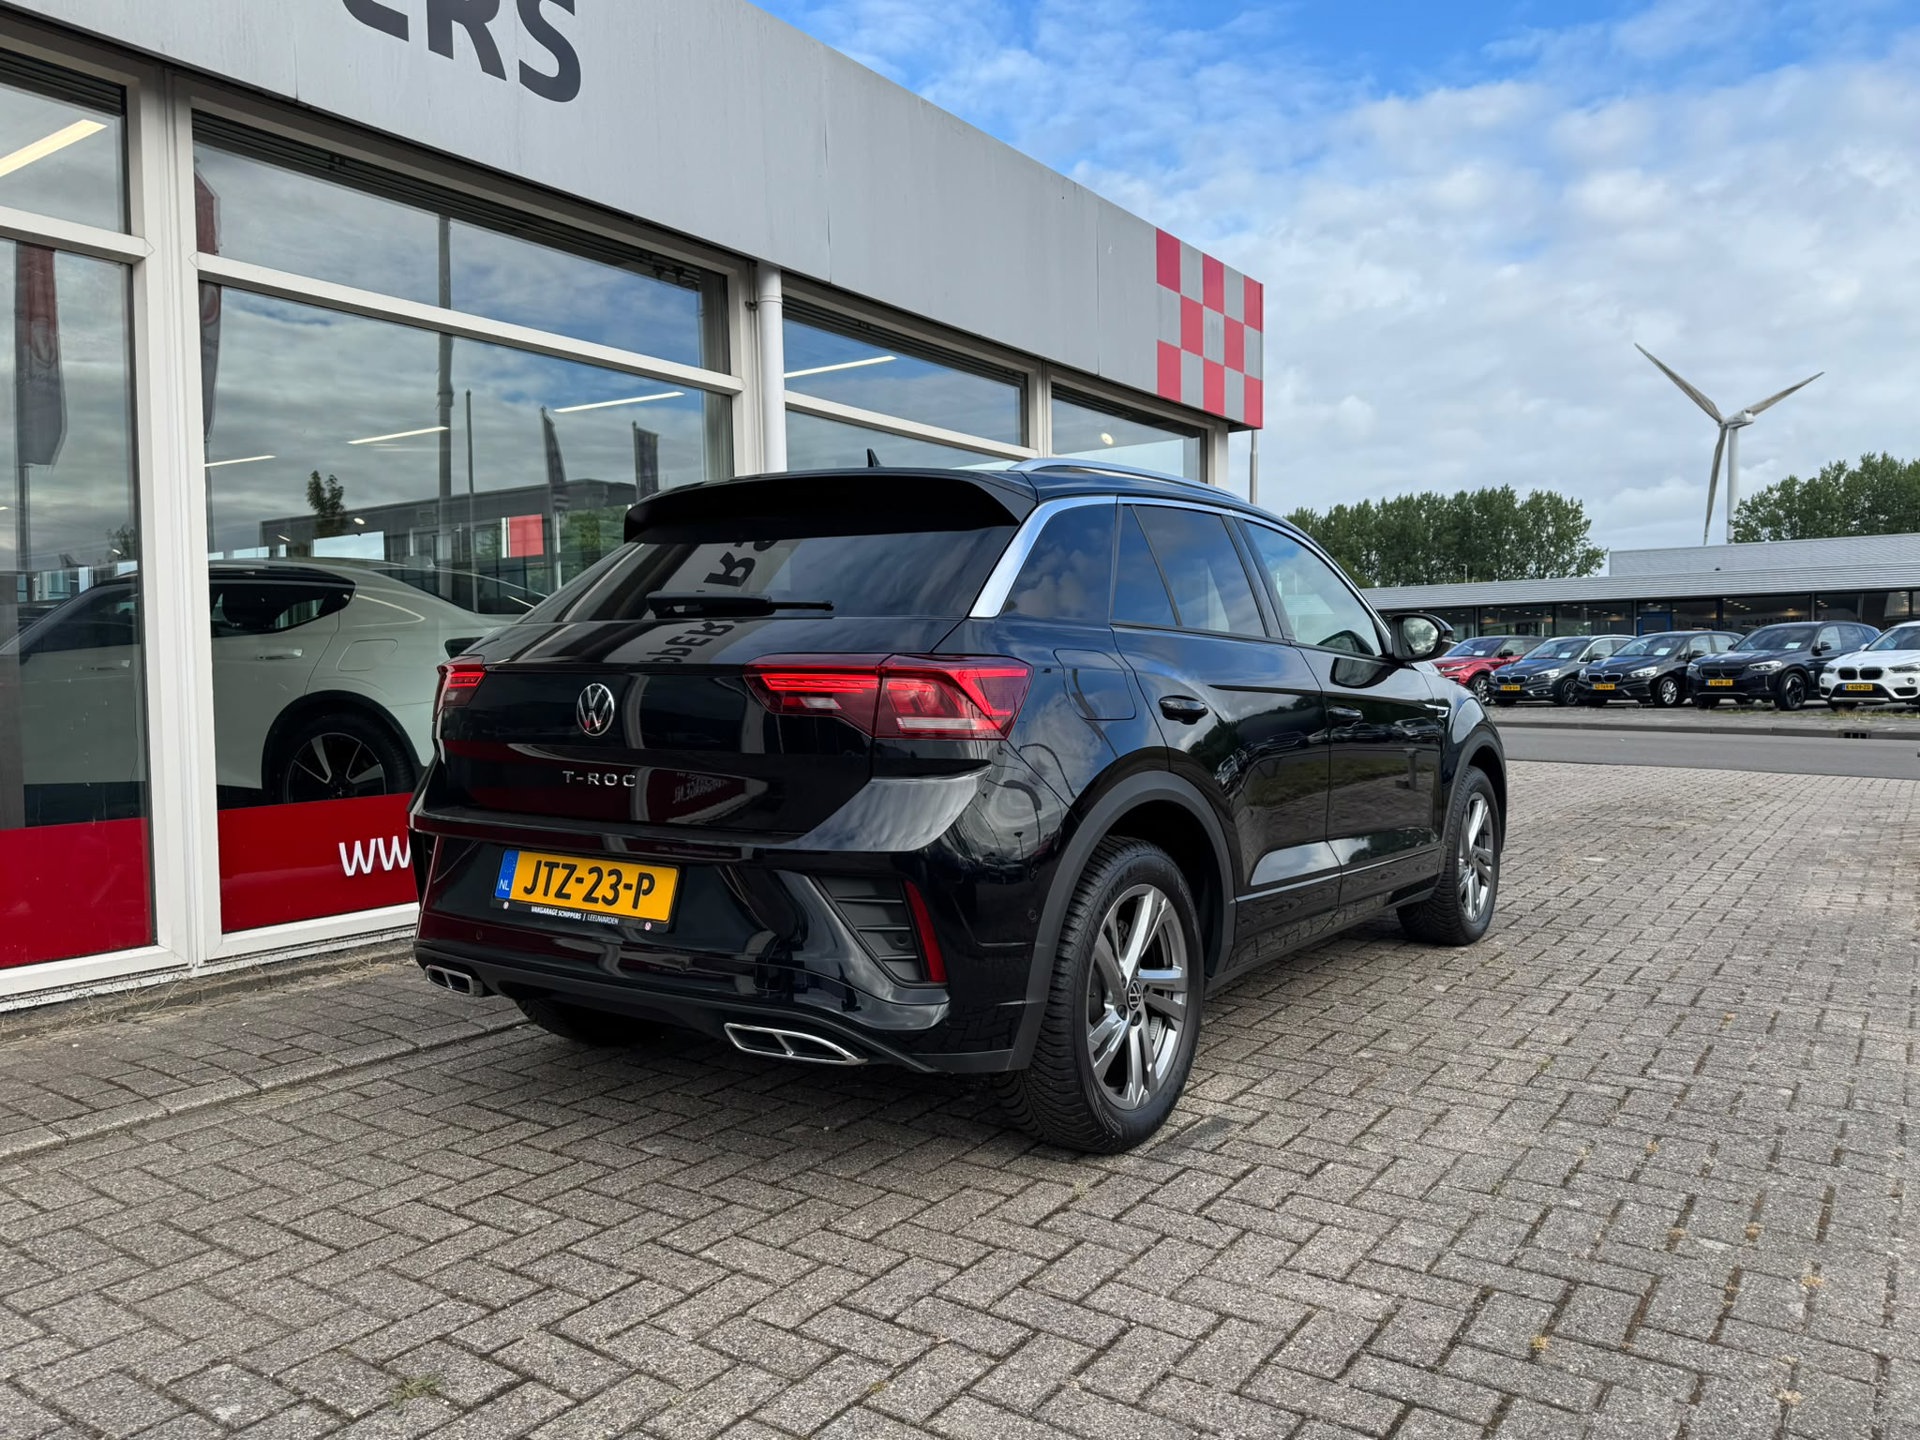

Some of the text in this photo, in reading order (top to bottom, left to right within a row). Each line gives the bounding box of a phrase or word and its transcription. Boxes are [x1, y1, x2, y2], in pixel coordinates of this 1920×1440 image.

[342, 0, 581, 103] RS
[562, 770, 636, 787] T-ROC
[498, 879, 510, 891] NL
[522, 859, 656, 910] JTZ-23-P
[557, 910, 582, 920] SCHIPPERS
